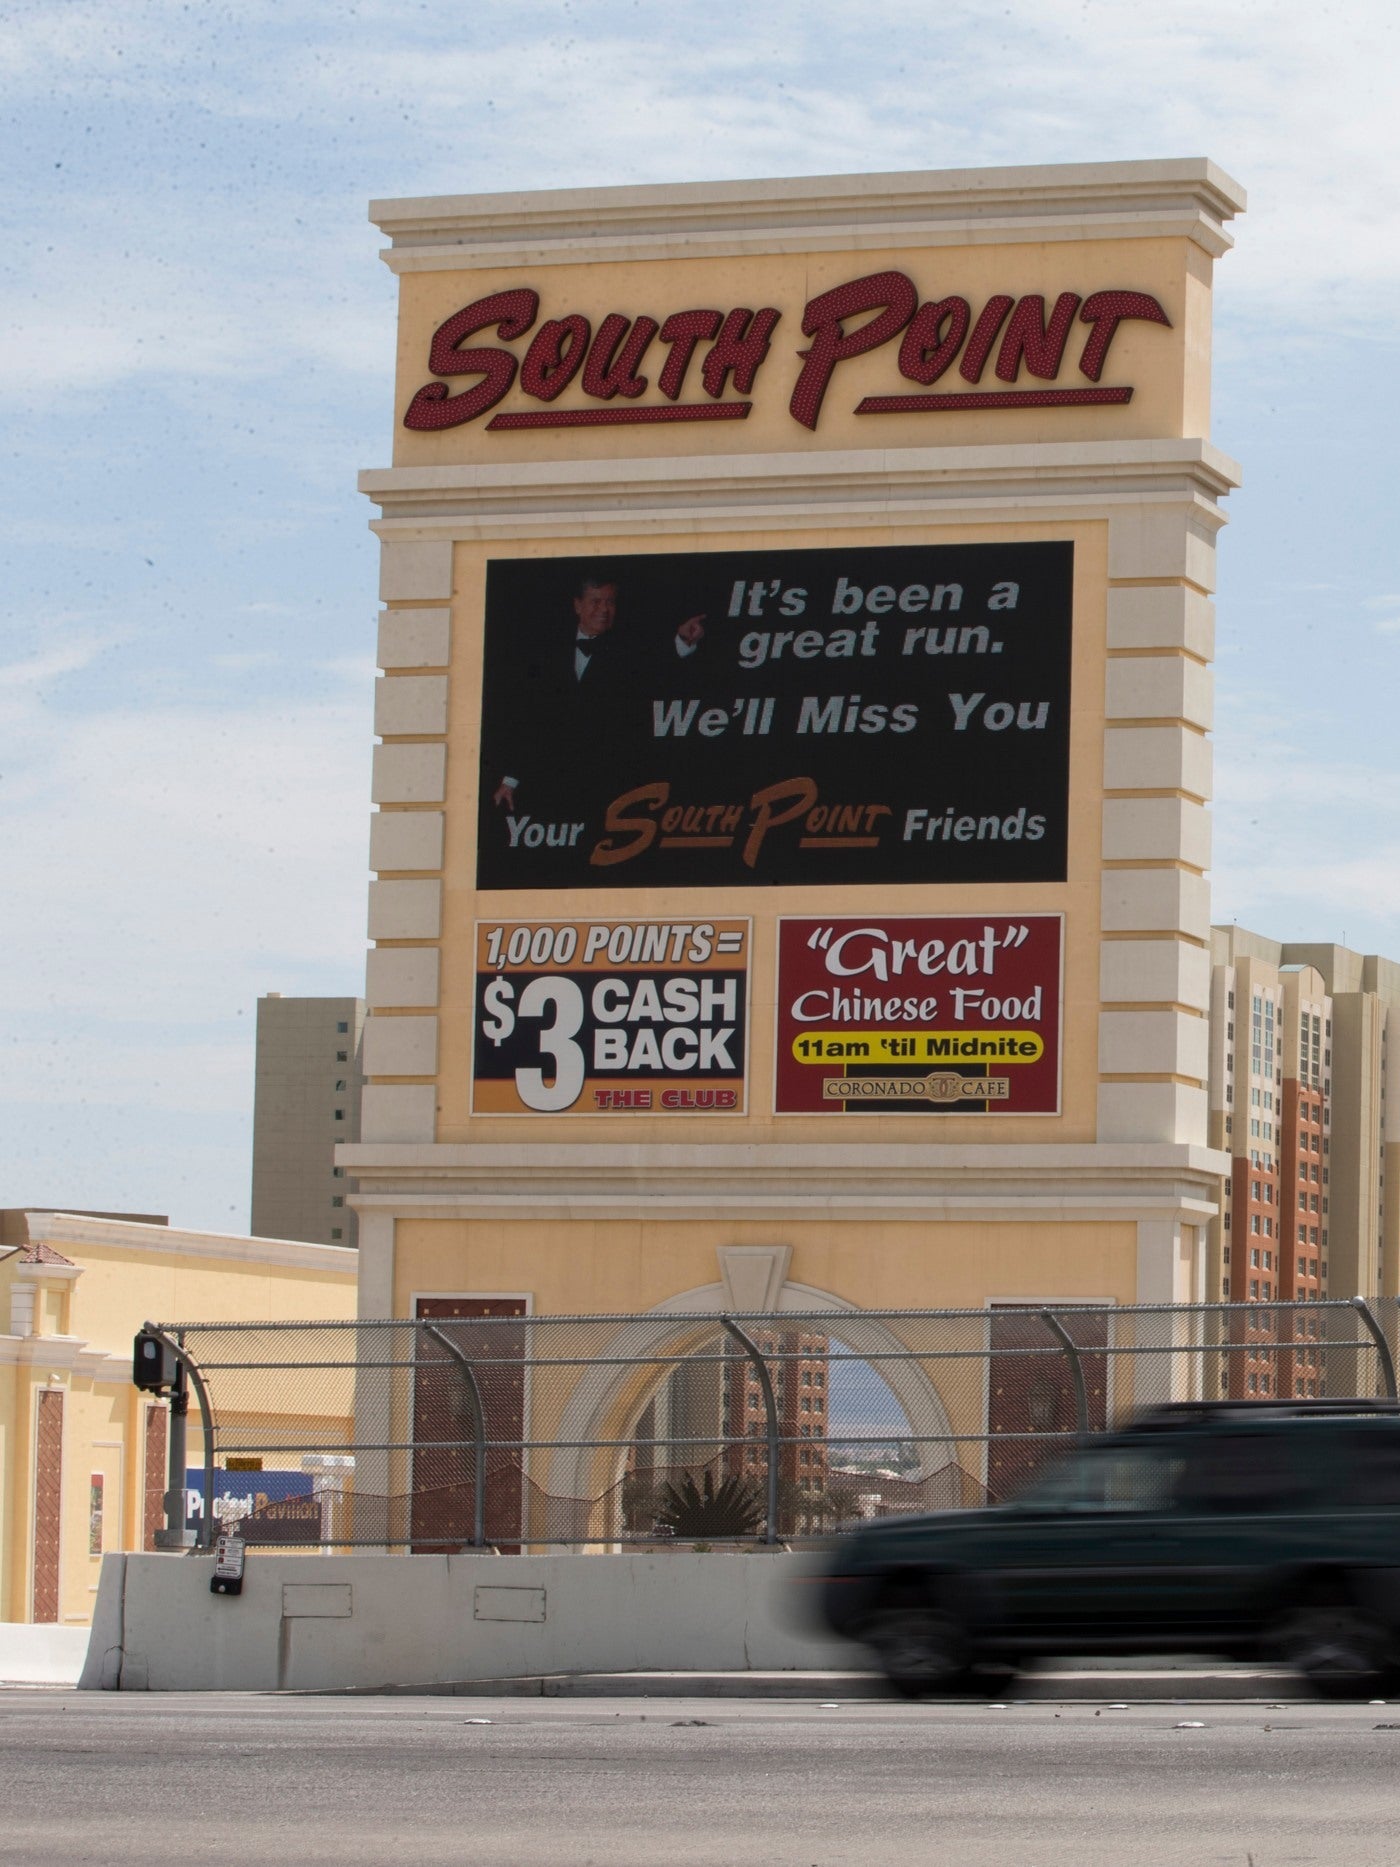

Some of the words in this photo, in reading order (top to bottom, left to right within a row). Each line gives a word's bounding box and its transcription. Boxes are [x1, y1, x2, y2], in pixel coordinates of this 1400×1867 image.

[403, 288, 782, 431] SOUTH
[789, 270, 1173, 432] POINT
[728, 580, 808, 617] It's
[832, 577, 963, 614] been
[987, 581, 1020, 610] a
[738, 622, 879, 668] great
[901, 624, 1004, 656] run.
[652, 698, 774, 737] We'll
[796, 695, 919, 734] Miss
[948, 693, 1050, 731] You
[505, 817, 584, 848] Your
[742, 776, 893, 868] POINT
[903, 808, 1046, 842] Friends
[486, 926, 578, 970] 1,000
[806, 925, 1029, 981] “Great”
[591, 978, 737, 1023] CASH
[791, 986, 938, 1022] Chinese
[949, 985, 1042, 1021] Food
[482, 975, 585, 1111] $3
[593, 1027, 737, 1071] BACK
[798, 1040, 870, 1057] 11am
[880, 1038, 916, 1056] 'til
[926, 1037, 1038, 1057] Midnite
[594, 1090, 652, 1108] THE
[660, 1089, 737, 1108] CLUB
[826, 1081, 926, 1096] CORONADO
[961, 1081, 1006, 1096] CAFE
